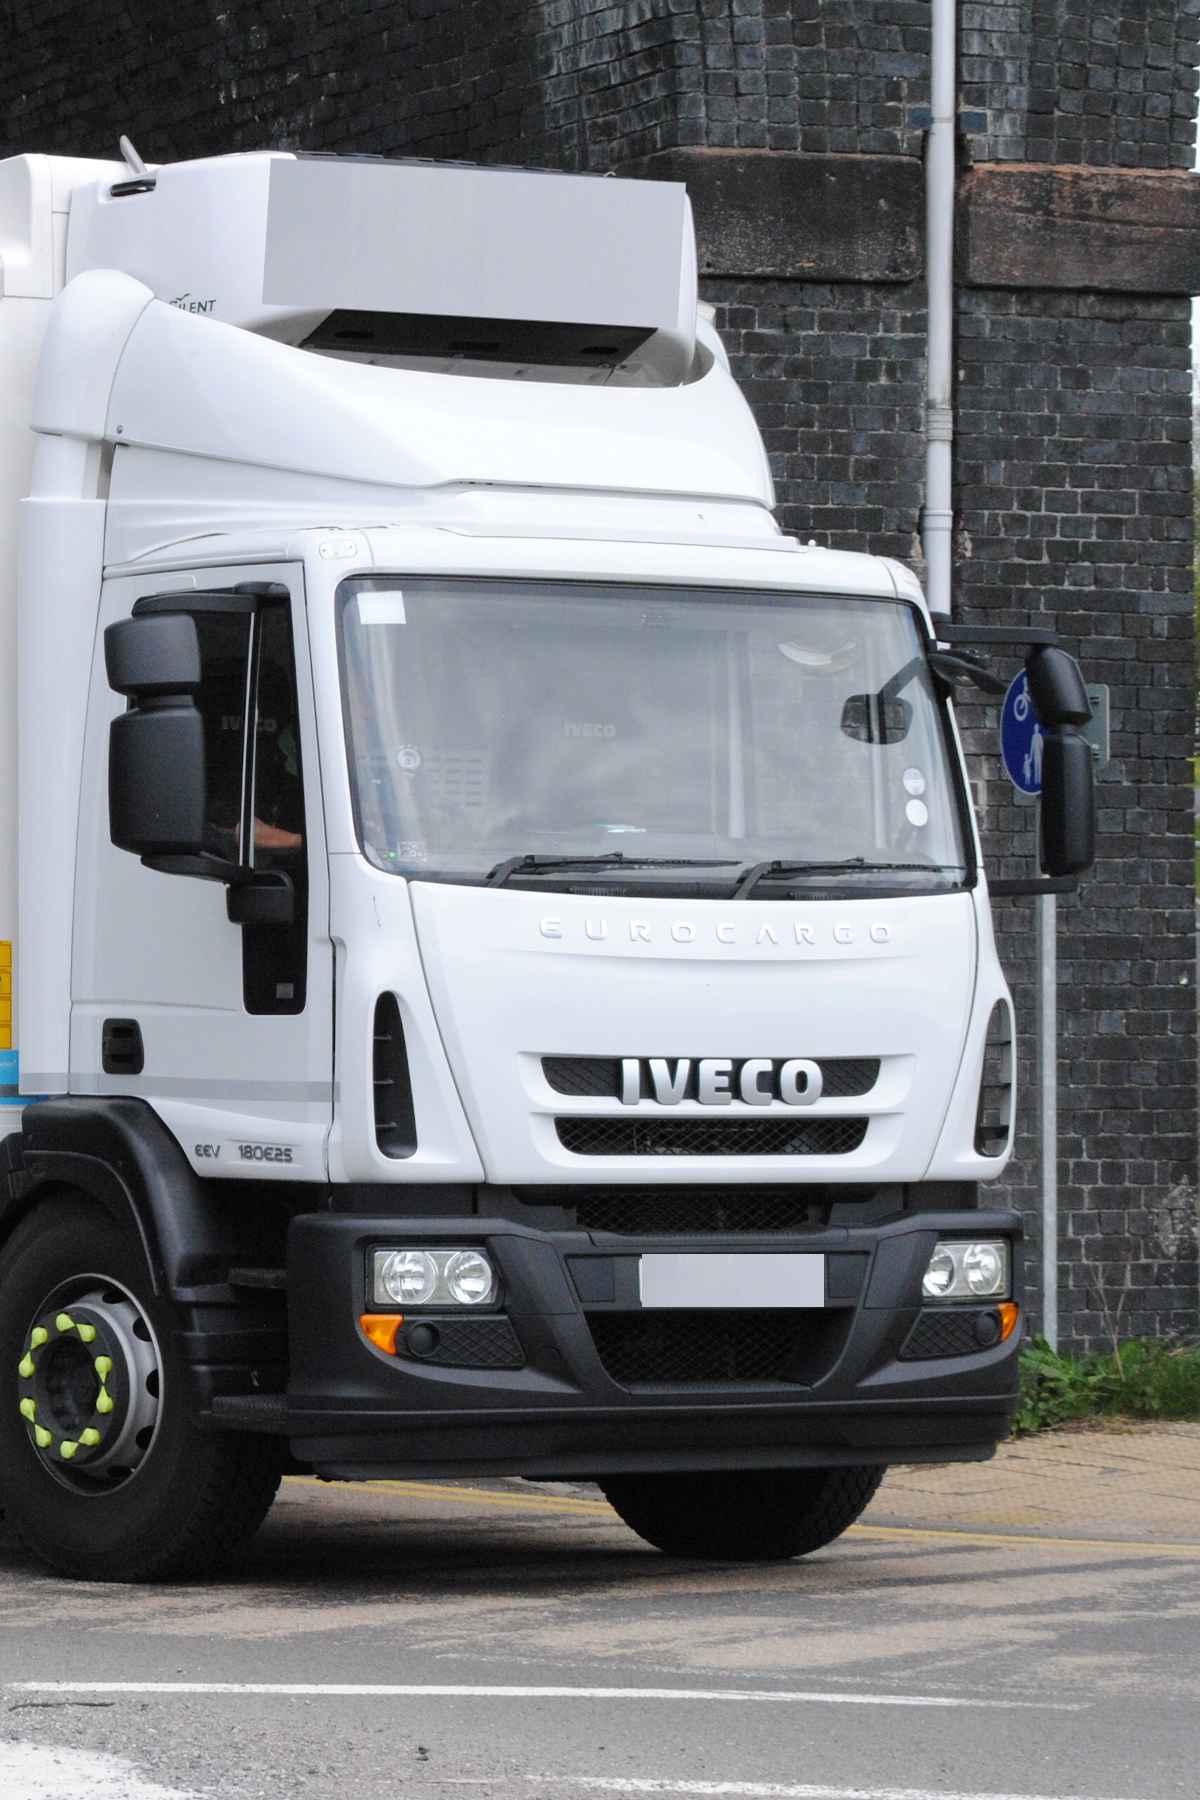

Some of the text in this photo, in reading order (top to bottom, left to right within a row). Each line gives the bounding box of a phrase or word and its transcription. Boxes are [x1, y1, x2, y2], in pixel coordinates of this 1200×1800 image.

[169, 299, 217, 313] ILENT
[221, 715, 278, 732] IVO
[538, 917, 894, 945] EUROCARGO
[621, 1058, 824, 1106] IVECO
[194, 1144, 293, 1163] EEV 180E25
